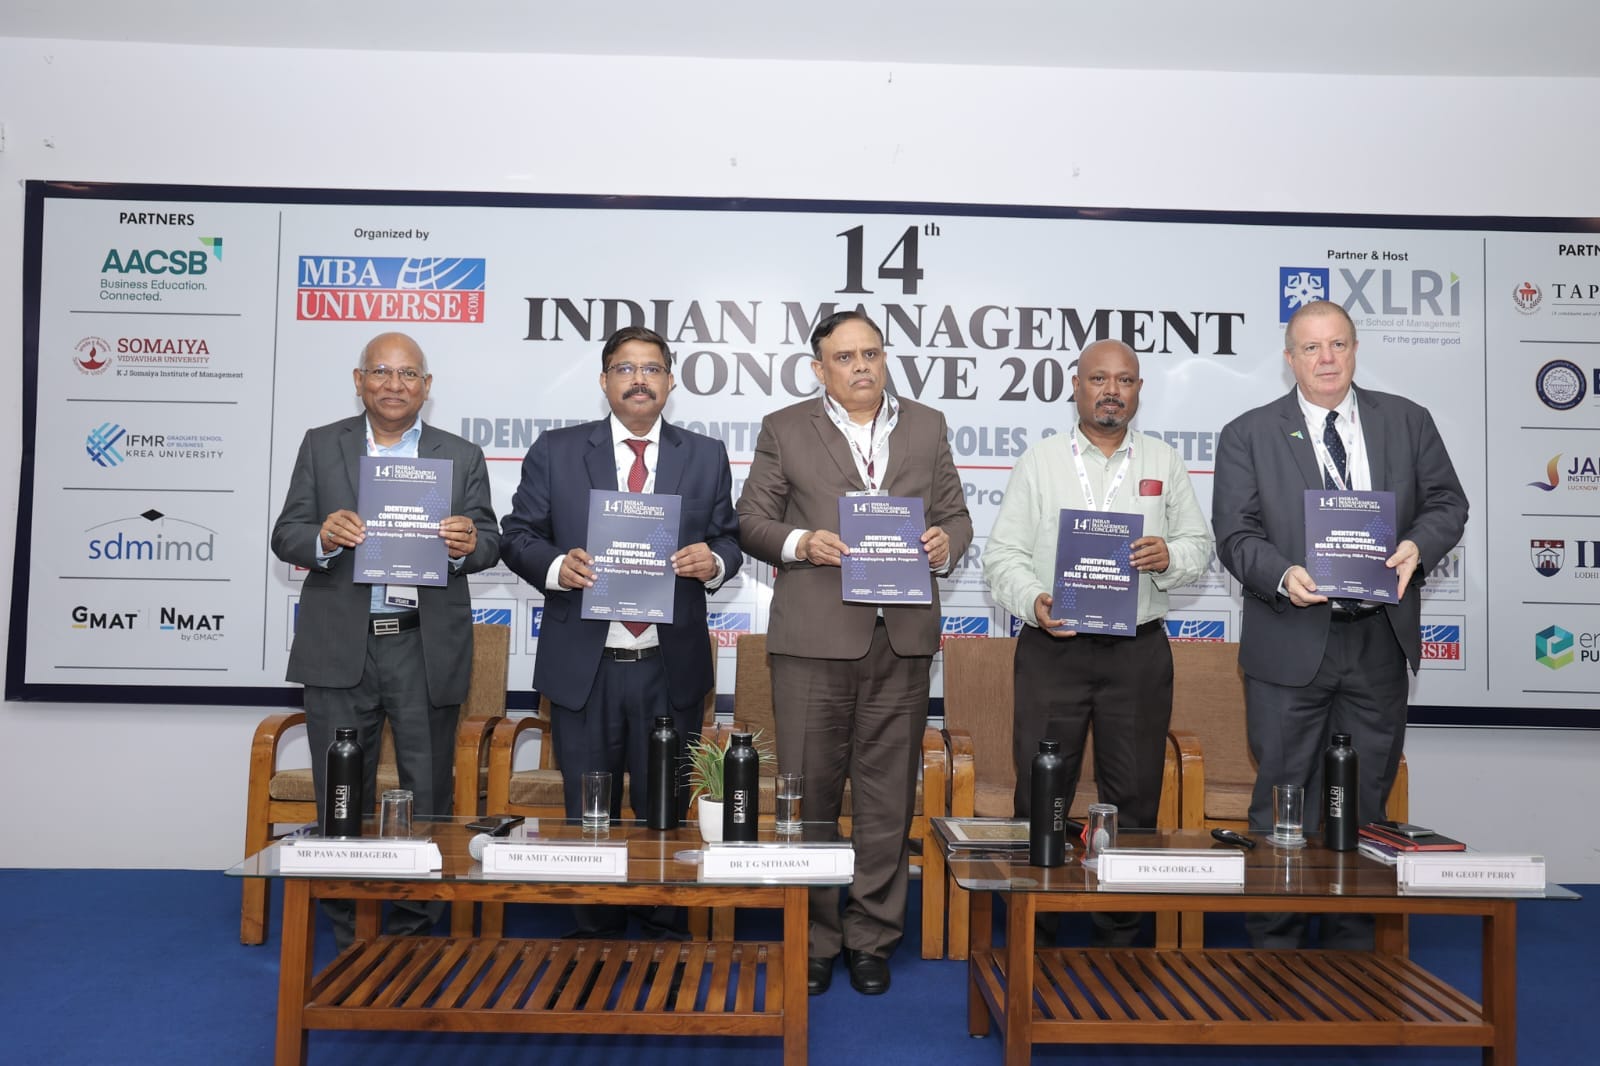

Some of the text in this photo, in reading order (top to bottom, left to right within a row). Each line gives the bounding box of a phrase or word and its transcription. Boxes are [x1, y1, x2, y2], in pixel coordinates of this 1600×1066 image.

[119, 212, 195, 226] PARTNERS
[354, 228, 430, 242] Organized by
[1327, 250, 1409, 262] Partner & Host
[101, 249, 208, 275] AACSB
[301, 258, 382, 287] MBA
[100, 279, 208, 291] Business Education.
[99, 290, 162, 302] Connected.
[299, 290, 462, 320] UNIVERSE
[523, 297, 762, 344] INDIAN
[1365, 318, 1395, 327] School
[1396, 318, 1405, 328] of
[1406, 320, 1461, 330] Management
[117, 338, 210, 354] SOMAIYA
[1411, 336, 1439, 346] greater
[1440, 337, 1461, 345] good
[129, 370, 159, 378] Somaiya
[199, 371, 244, 379] Management
[671, 350, 978, 402] ONCVE
[126, 434, 165, 447] IFMR
[126, 450, 224, 458] KREA UNIVERSITY
[378, 513, 429, 521] CONTEMPORARY
[394, 521, 440, 529] COMPETENCIES
[88, 532, 214, 562] sdmimd
[612, 541, 651, 550] IDENTIFYING
[606, 548, 656, 558] CONTEMPORARY
[622, 558, 666, 566] COMPETENCIES
[1080, 557, 1116, 566] IDENTIFYING
[1074, 564, 1121, 574] CONTEMPORARY
[1089, 573, 1130, 582] COMPETENCIES
[72, 606, 225, 631] GMAT NMAT
[297, 850, 398, 859] MR PAWAN BHAGERIA
[508, 853, 602, 863] MR AMIT AGNIHOTRI
[730, 860, 742, 868] DR
[761, 860, 809, 868] SITHARAM
[1487, 871, 1516, 879] PERRY
